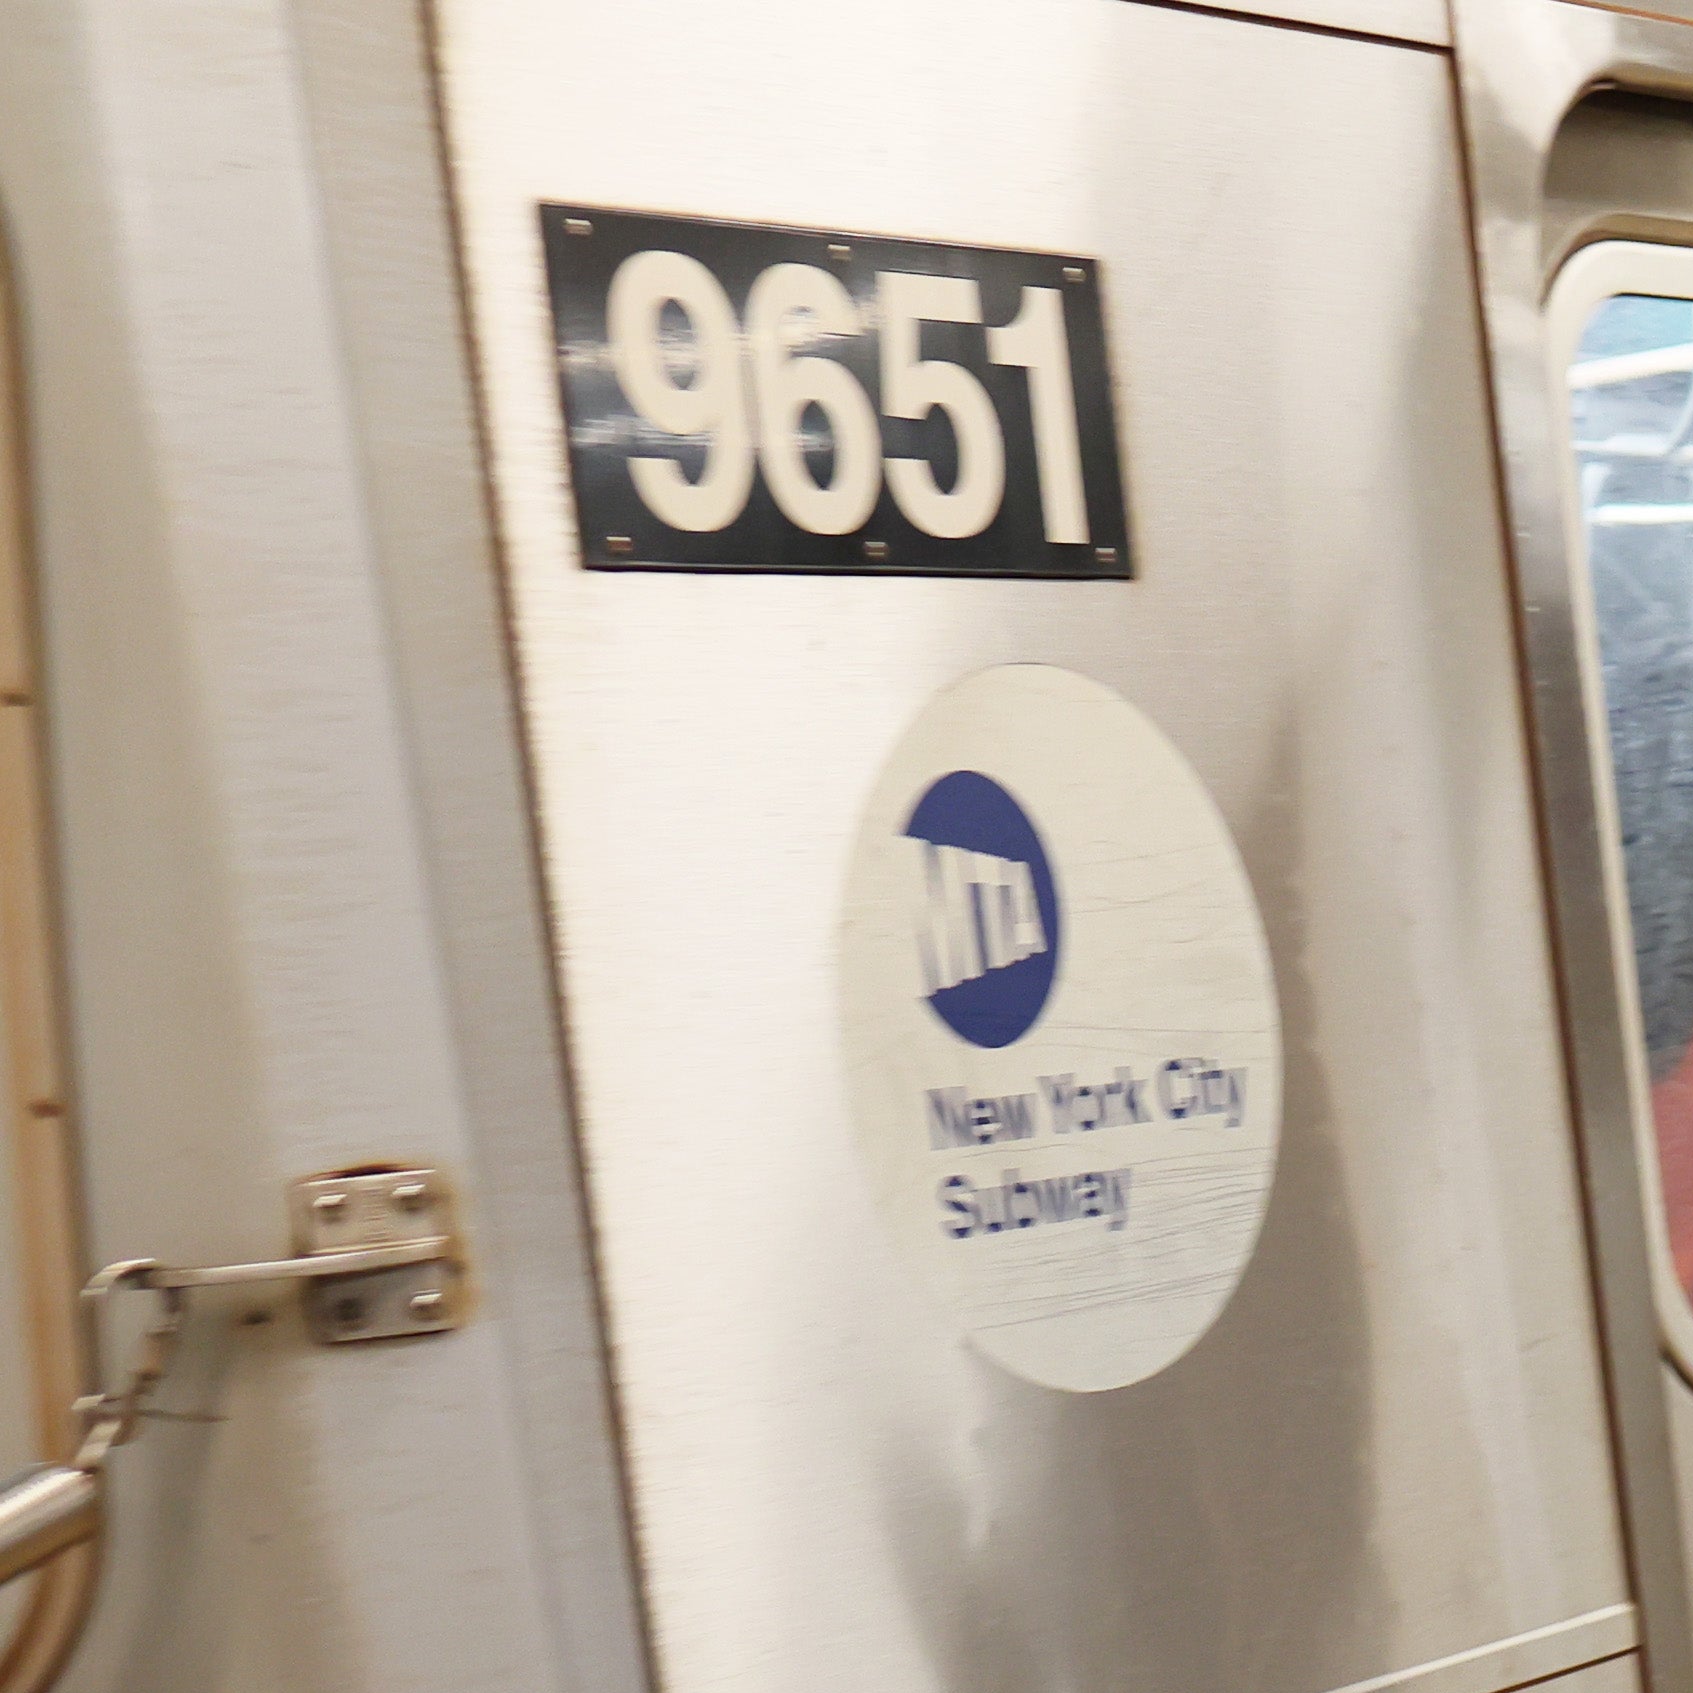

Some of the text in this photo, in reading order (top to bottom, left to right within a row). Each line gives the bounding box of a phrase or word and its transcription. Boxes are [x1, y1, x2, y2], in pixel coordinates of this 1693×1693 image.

[606, 250, 1091, 545] 9651
[926, 1057, 1247, 1151] New York City
[937, 1168, 1132, 1239] Subway
